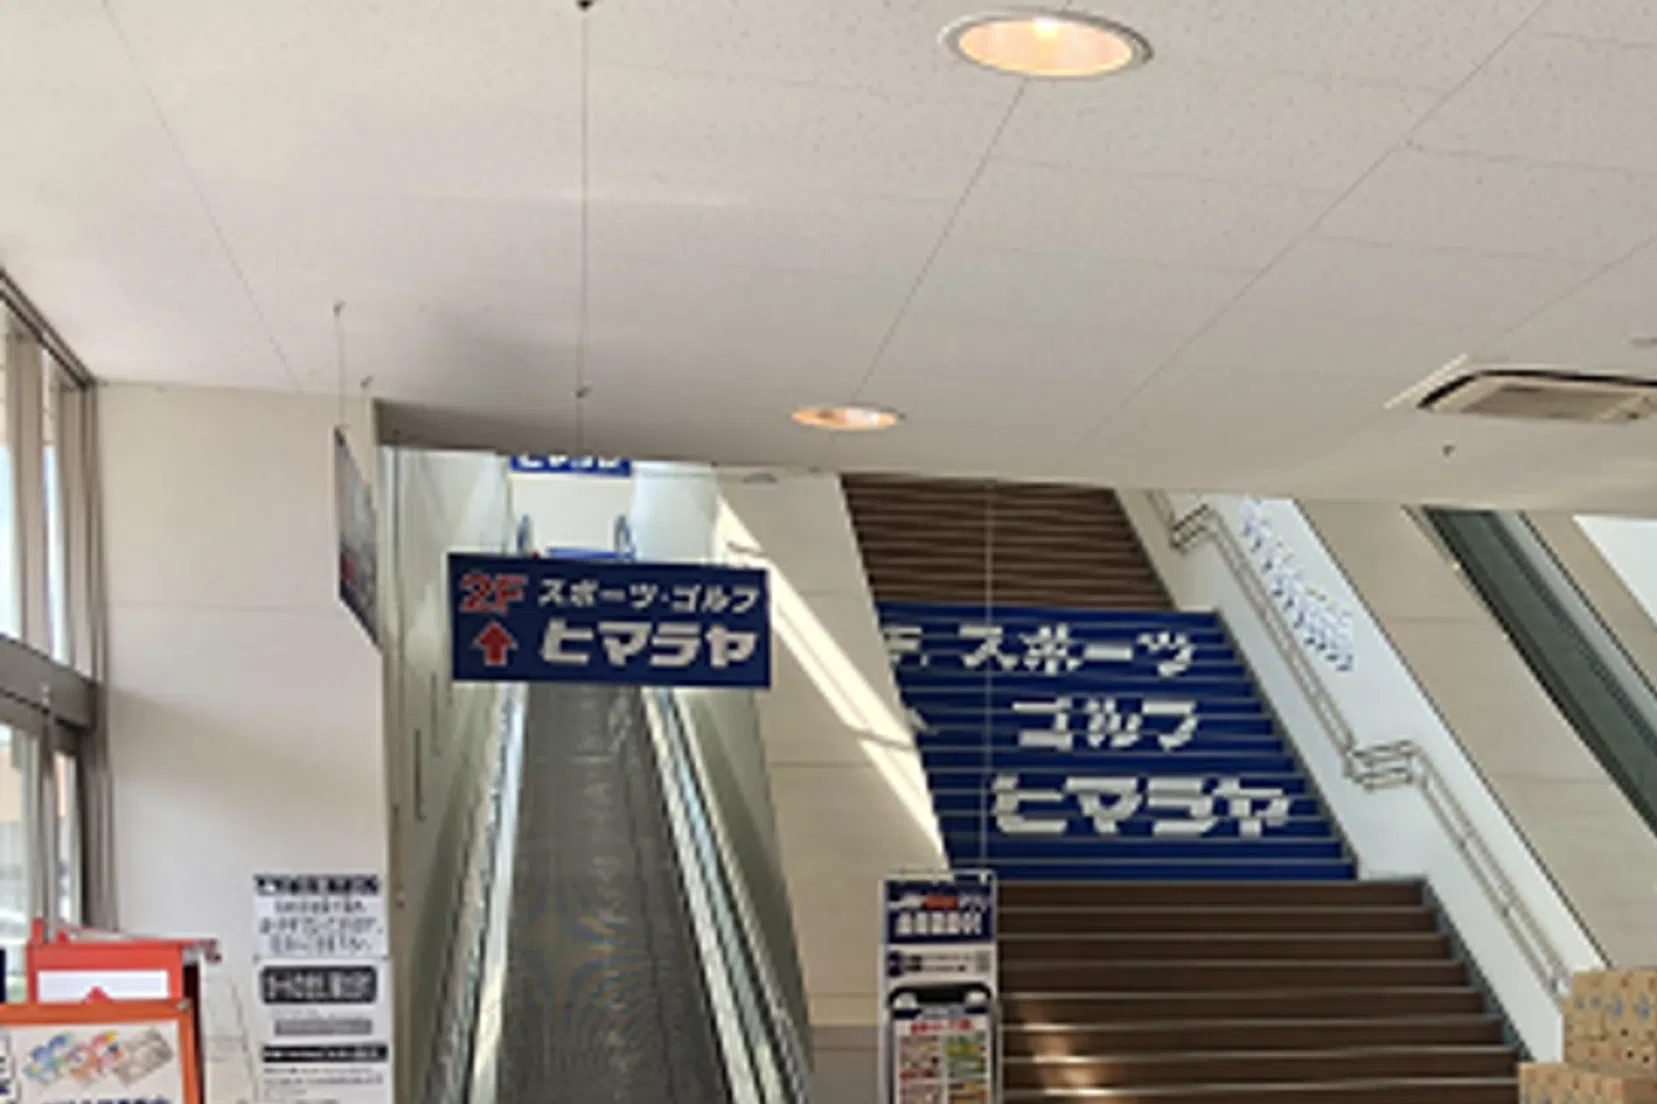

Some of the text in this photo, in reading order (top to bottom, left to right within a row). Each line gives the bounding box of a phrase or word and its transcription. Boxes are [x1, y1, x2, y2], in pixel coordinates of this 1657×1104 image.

[459, 572, 527, 613] 2F
[537, 577, 759, 614] スポーツ・ゴルフ
[542, 617, 759, 669] ヒマラヤ
[1012, 697, 1198, 750] ゴルフ
[993, 773, 1290, 837] ヒマラヤ
